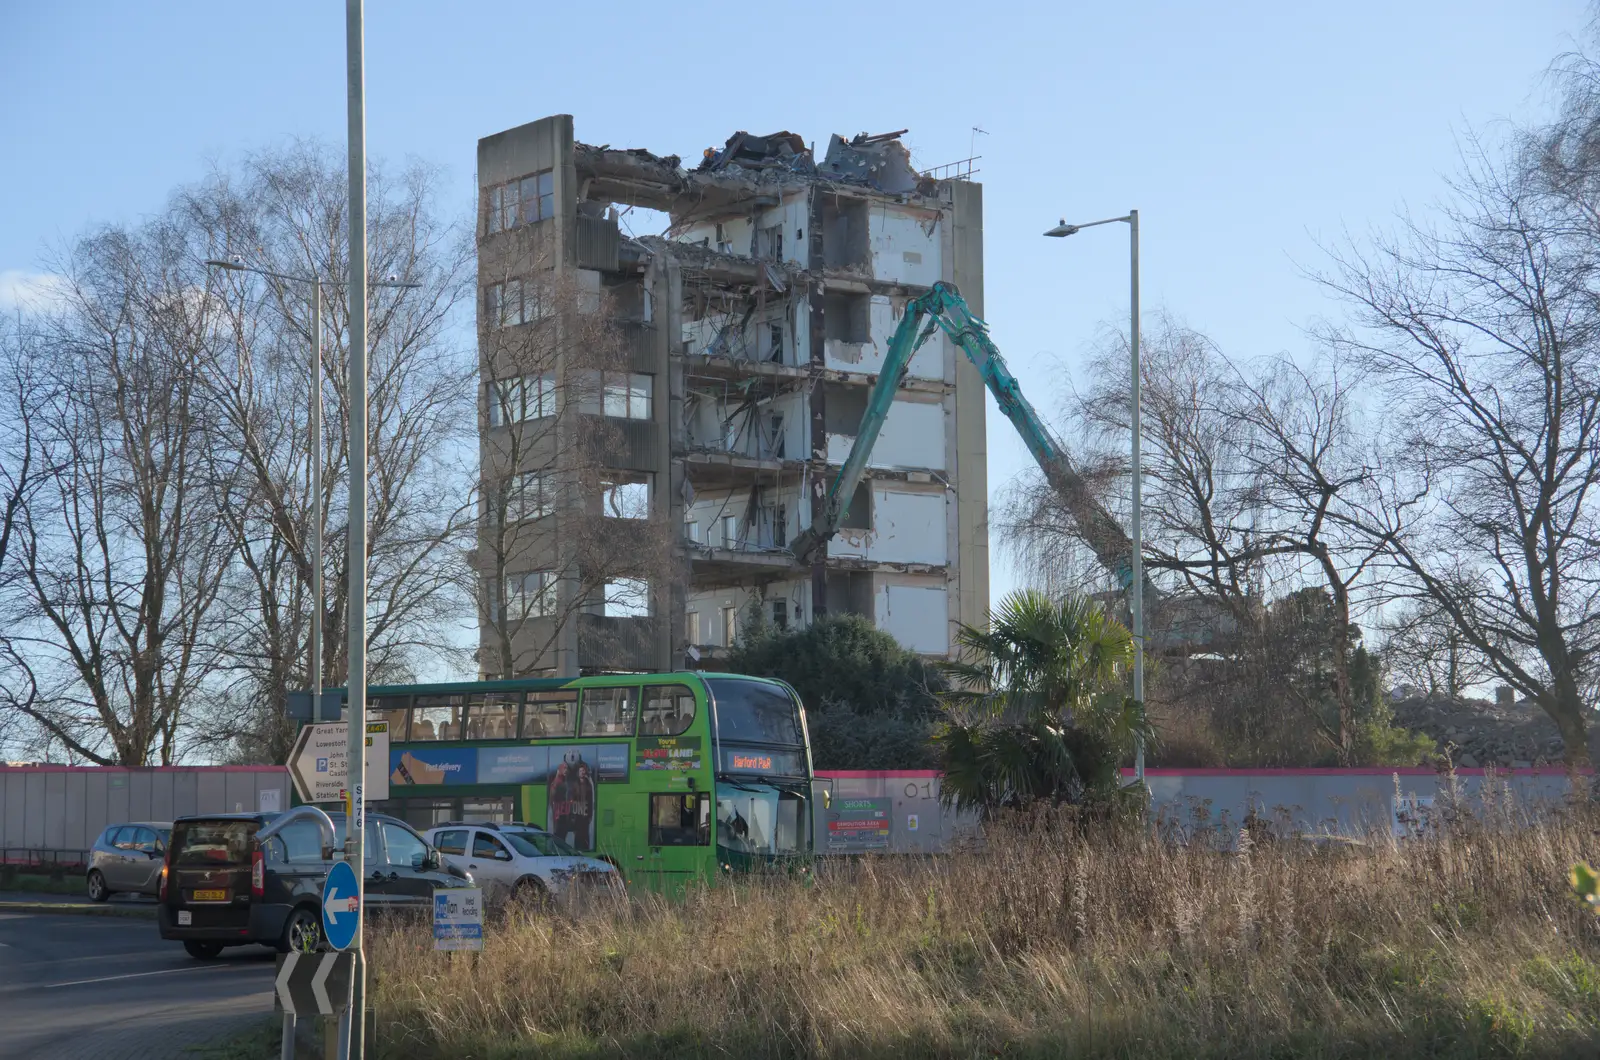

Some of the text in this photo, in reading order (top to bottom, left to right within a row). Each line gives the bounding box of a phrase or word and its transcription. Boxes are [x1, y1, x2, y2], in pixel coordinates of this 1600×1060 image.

[316, 727, 333, 735] Great
[316, 740, 347, 748] Lowestoft
[329, 751, 345, 759] John
[734, 755, 757, 769] Harford
[439, 762, 461, 772] delivery
[316, 791, 339, 799] Station
[844, 800, 872, 809] SHORTS
[434, 899, 458, 917] Anglian
